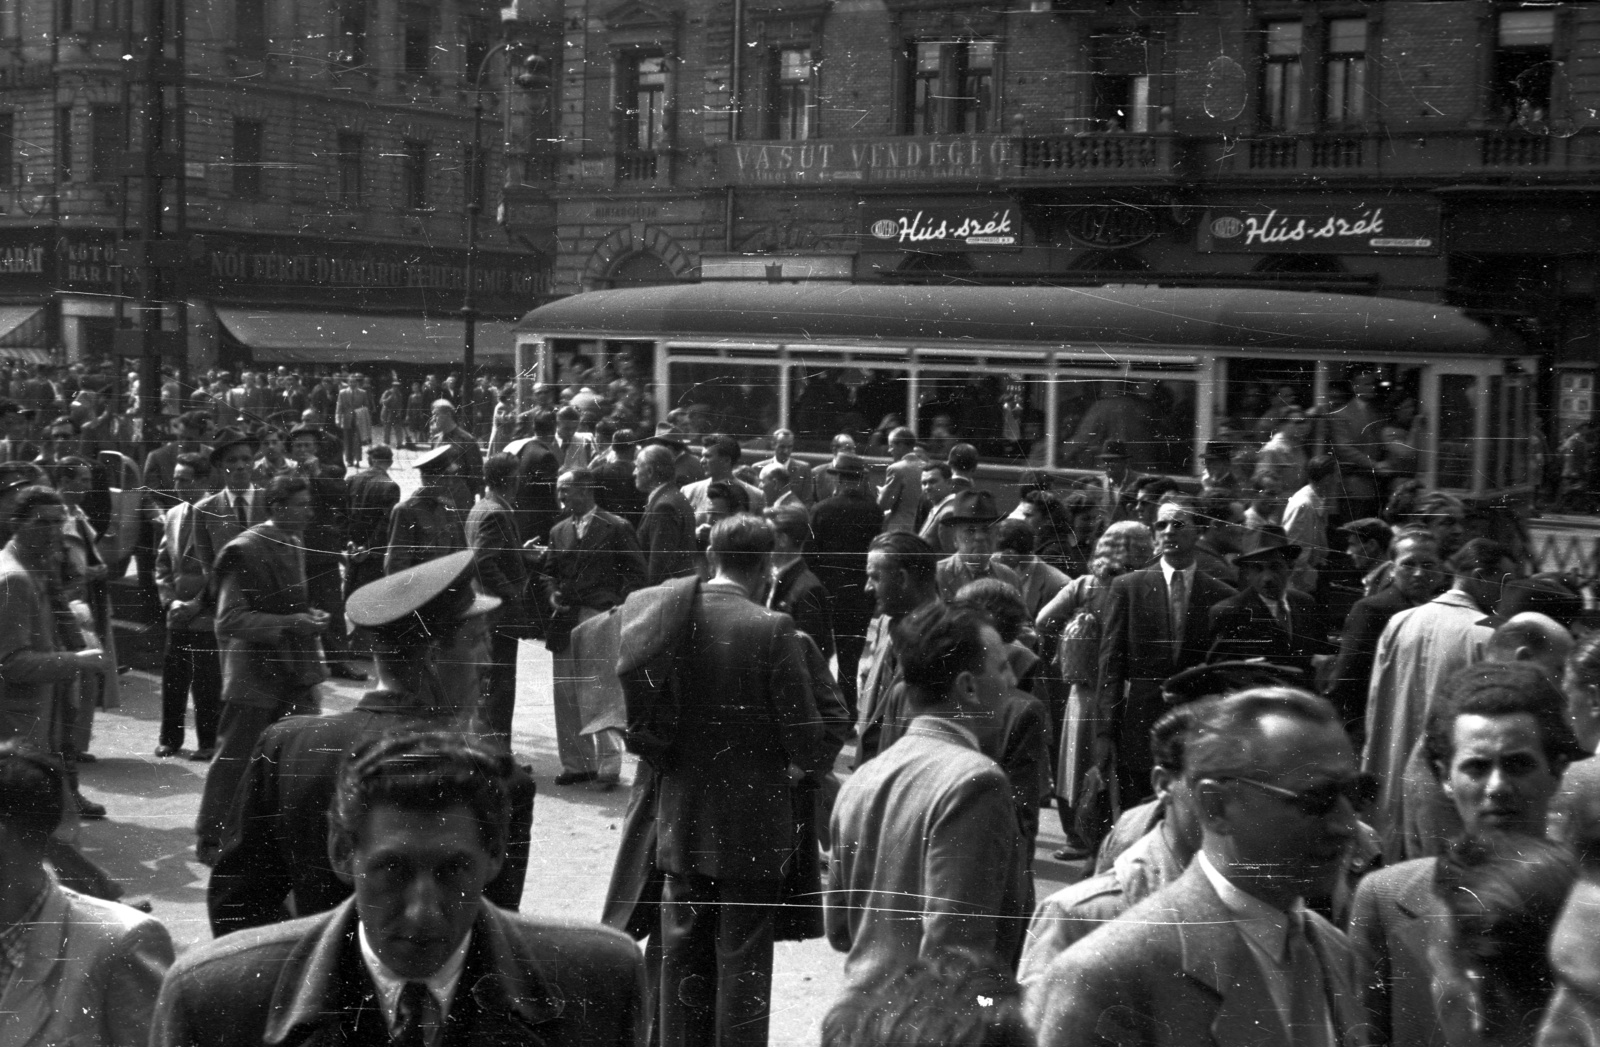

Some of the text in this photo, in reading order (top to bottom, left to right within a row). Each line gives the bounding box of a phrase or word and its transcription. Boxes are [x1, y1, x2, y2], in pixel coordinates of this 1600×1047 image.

[897, 209, 1013, 244] Hús-szék
[1244, 207, 1386, 246] Hús-szék
[406, 261, 507, 292] FEHÉREMŰ
